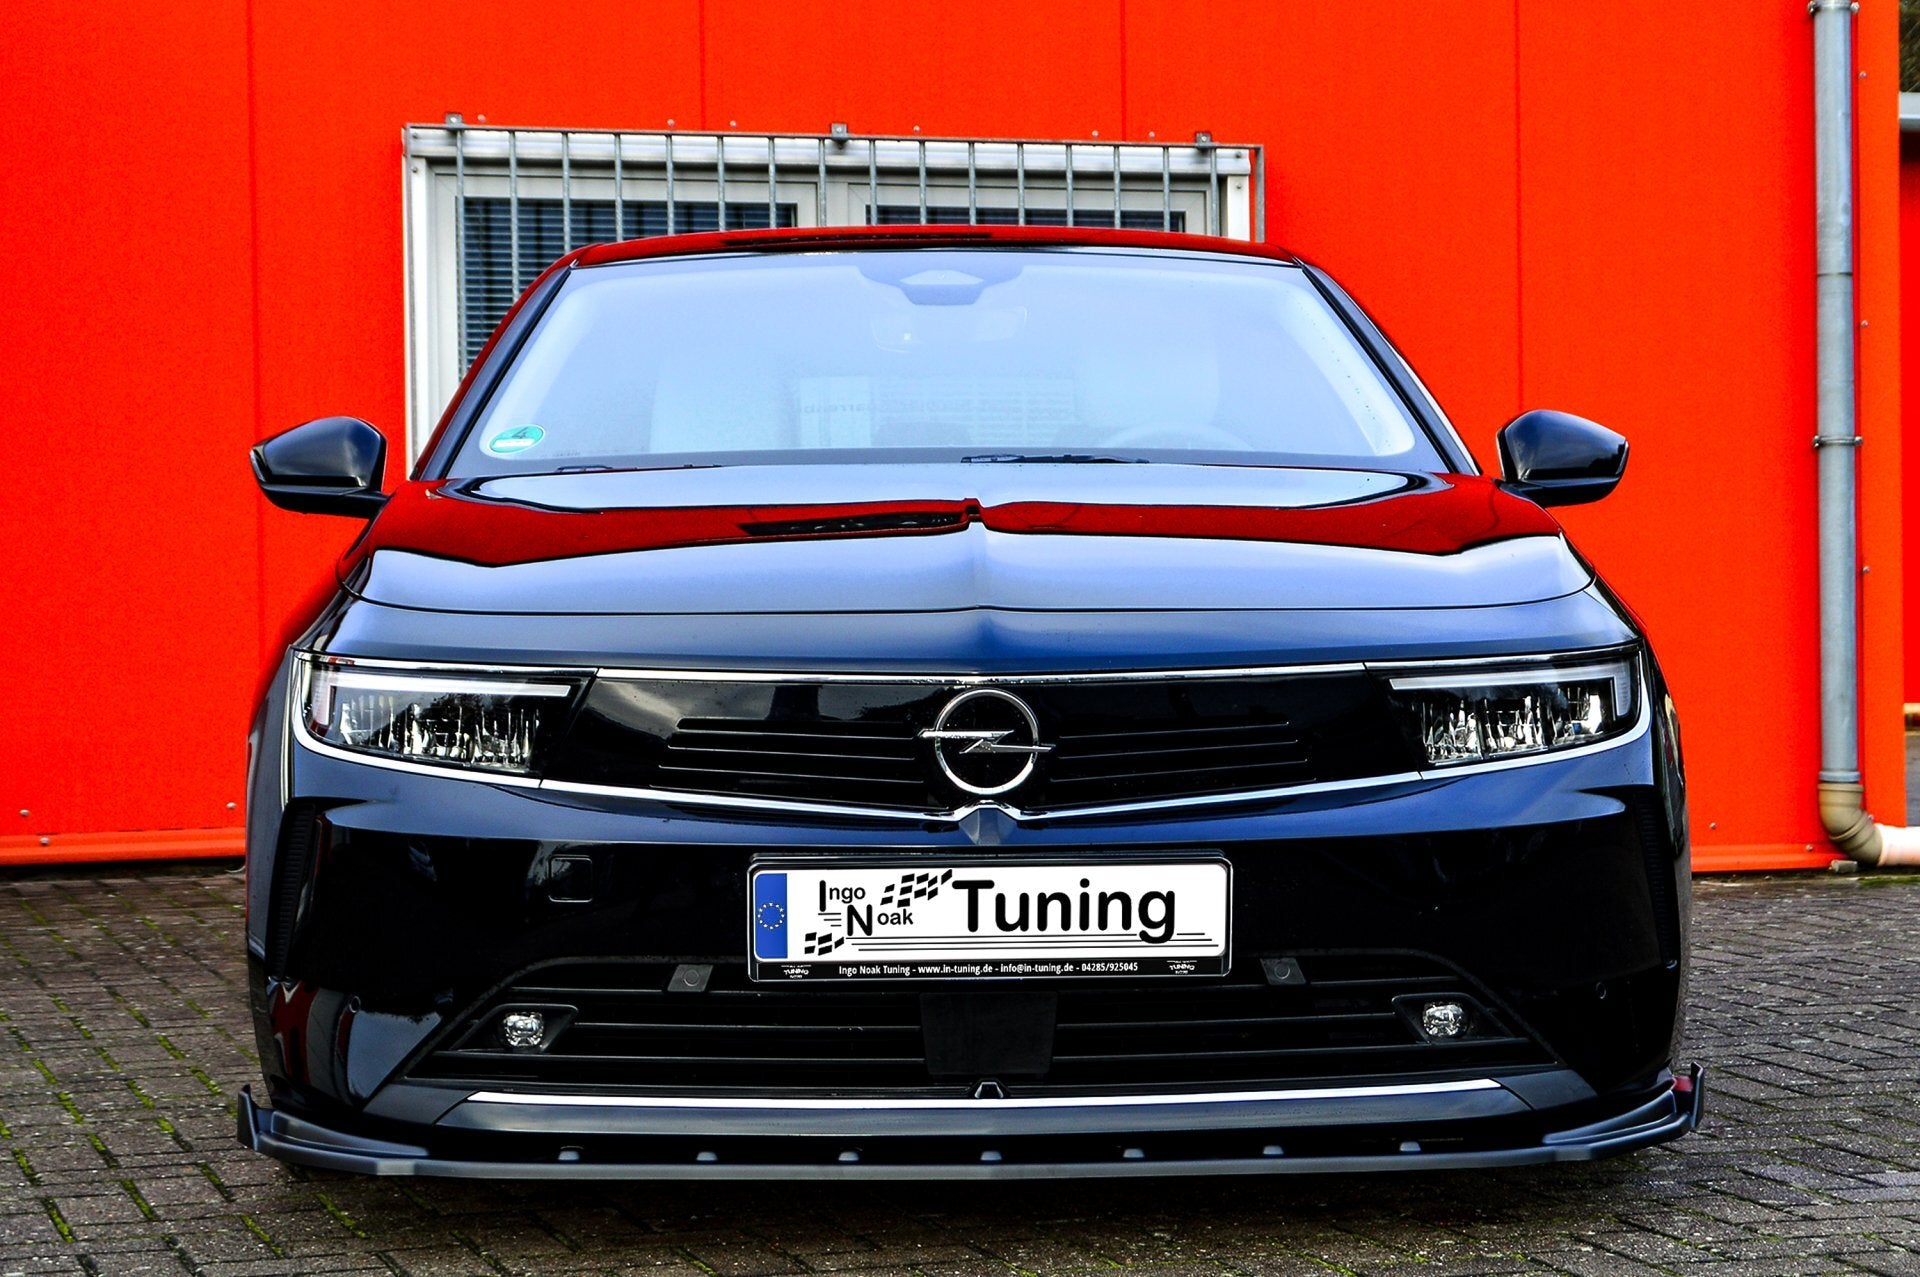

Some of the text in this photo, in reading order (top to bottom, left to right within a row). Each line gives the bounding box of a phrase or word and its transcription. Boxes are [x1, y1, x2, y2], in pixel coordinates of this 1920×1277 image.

[819, 880, 866, 912] Ingo
[951, 878, 1176, 944] Tuning
[847, 904, 913, 936] Noak
[839, 965, 858, 977] Ingo
[860, 965, 881, 975] Noak
[883, 964, 911, 977] Tuning
[917, 964, 993, 976] www.in-tuning.de
[1000, 963, 1074, 975] info@in-tuning.de
[1081, 962, 1138, 973] 04285/925045
